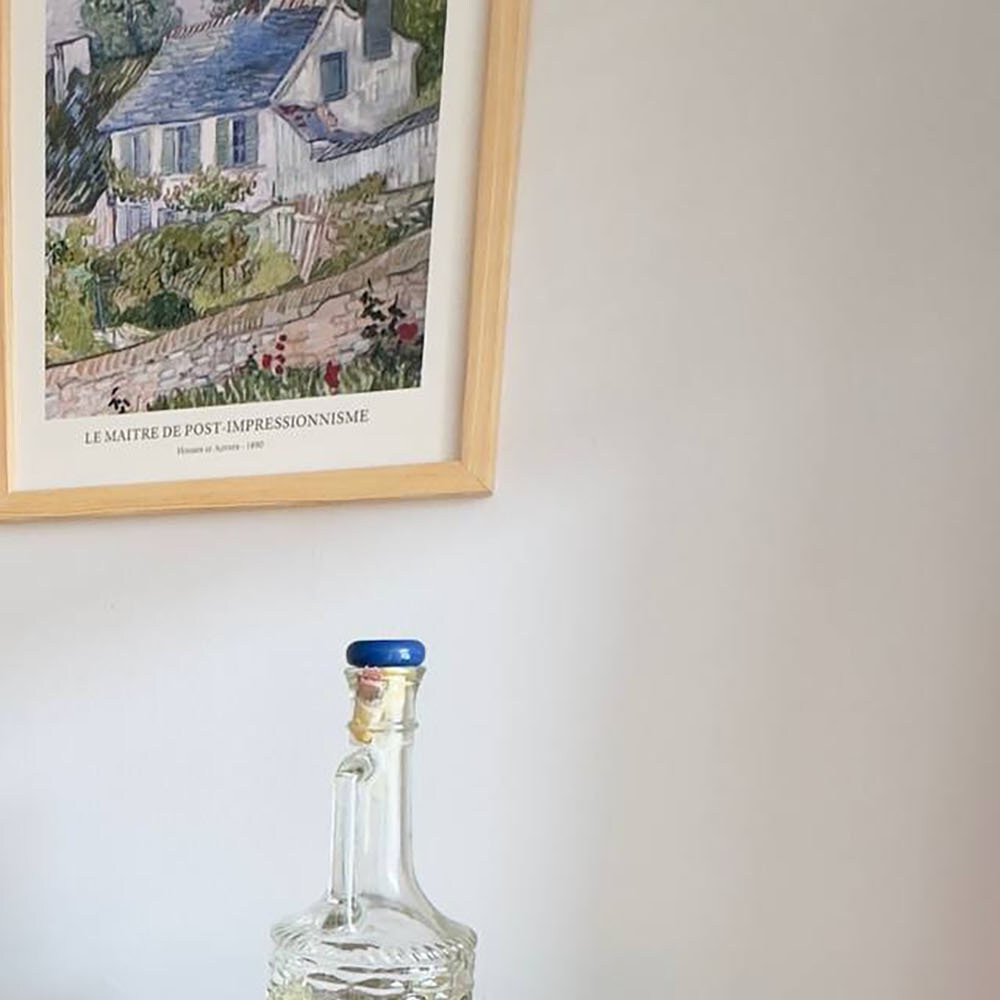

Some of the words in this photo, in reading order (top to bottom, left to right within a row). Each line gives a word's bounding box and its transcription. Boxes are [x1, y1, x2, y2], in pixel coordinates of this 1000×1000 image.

[85, 431, 101, 444] LE
[162, 425, 181, 438] DE
[185, 409, 369, 436] POST-IMPRESSIONNISME
